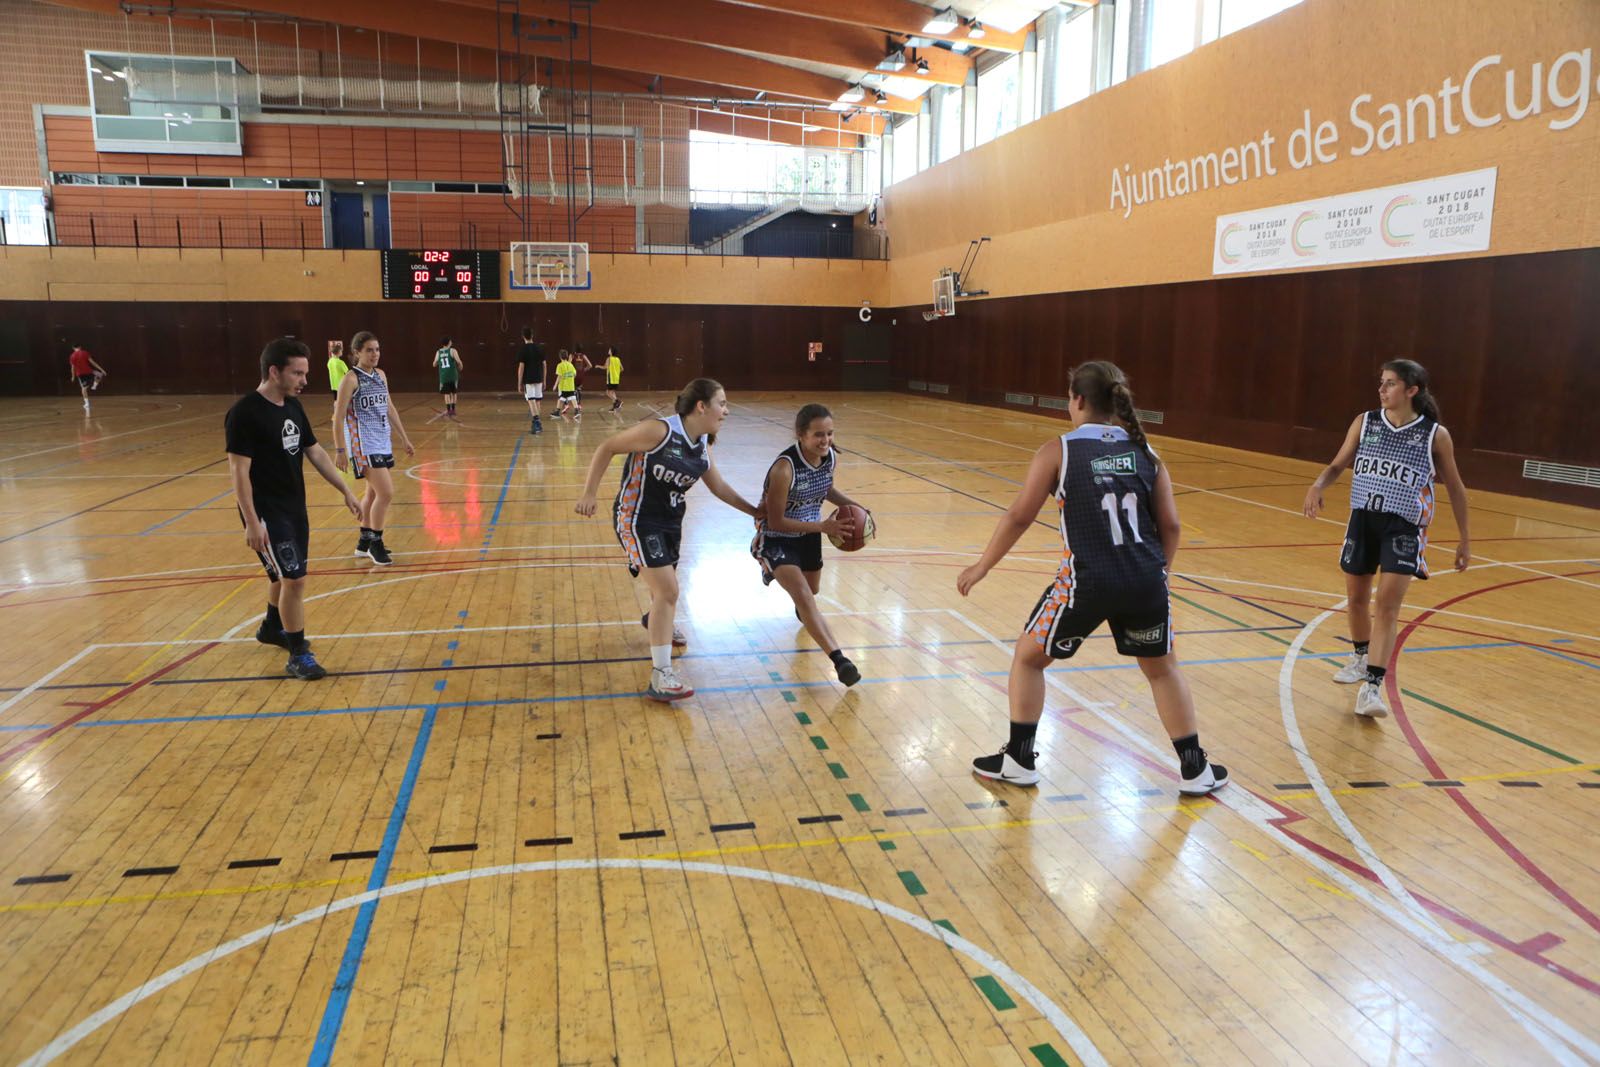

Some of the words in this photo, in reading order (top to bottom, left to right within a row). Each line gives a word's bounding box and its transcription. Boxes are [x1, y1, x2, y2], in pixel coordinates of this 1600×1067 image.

[1110, 130, 1277, 219] Ajuntament
[1288, 109, 1339, 170] de
[1350, 48, 1600, 158] SantCug
[1427, 193, 1451, 205] SANT
[1453, 187, 1485, 201] CUGAT
[1327, 209, 1346, 220] SANT
[1348, 205, 1373, 217] CUGAT
[1438, 202, 1469, 215] 2018
[1249, 222, 1265, 231] SANT
[1266, 219, 1287, 229] CUGAT
[1337, 217, 1361, 228] 2018
[1256, 230, 1277, 239] 2018
[414, 271, 429, 282] 00
[456, 272, 471, 282] 00
[414, 285, 421, 293] 0
[462, 285, 468, 293] 0
[859, 306, 872, 322] C
[440, 357, 450, 369] 11
[1101, 492, 1143, 546] 11
